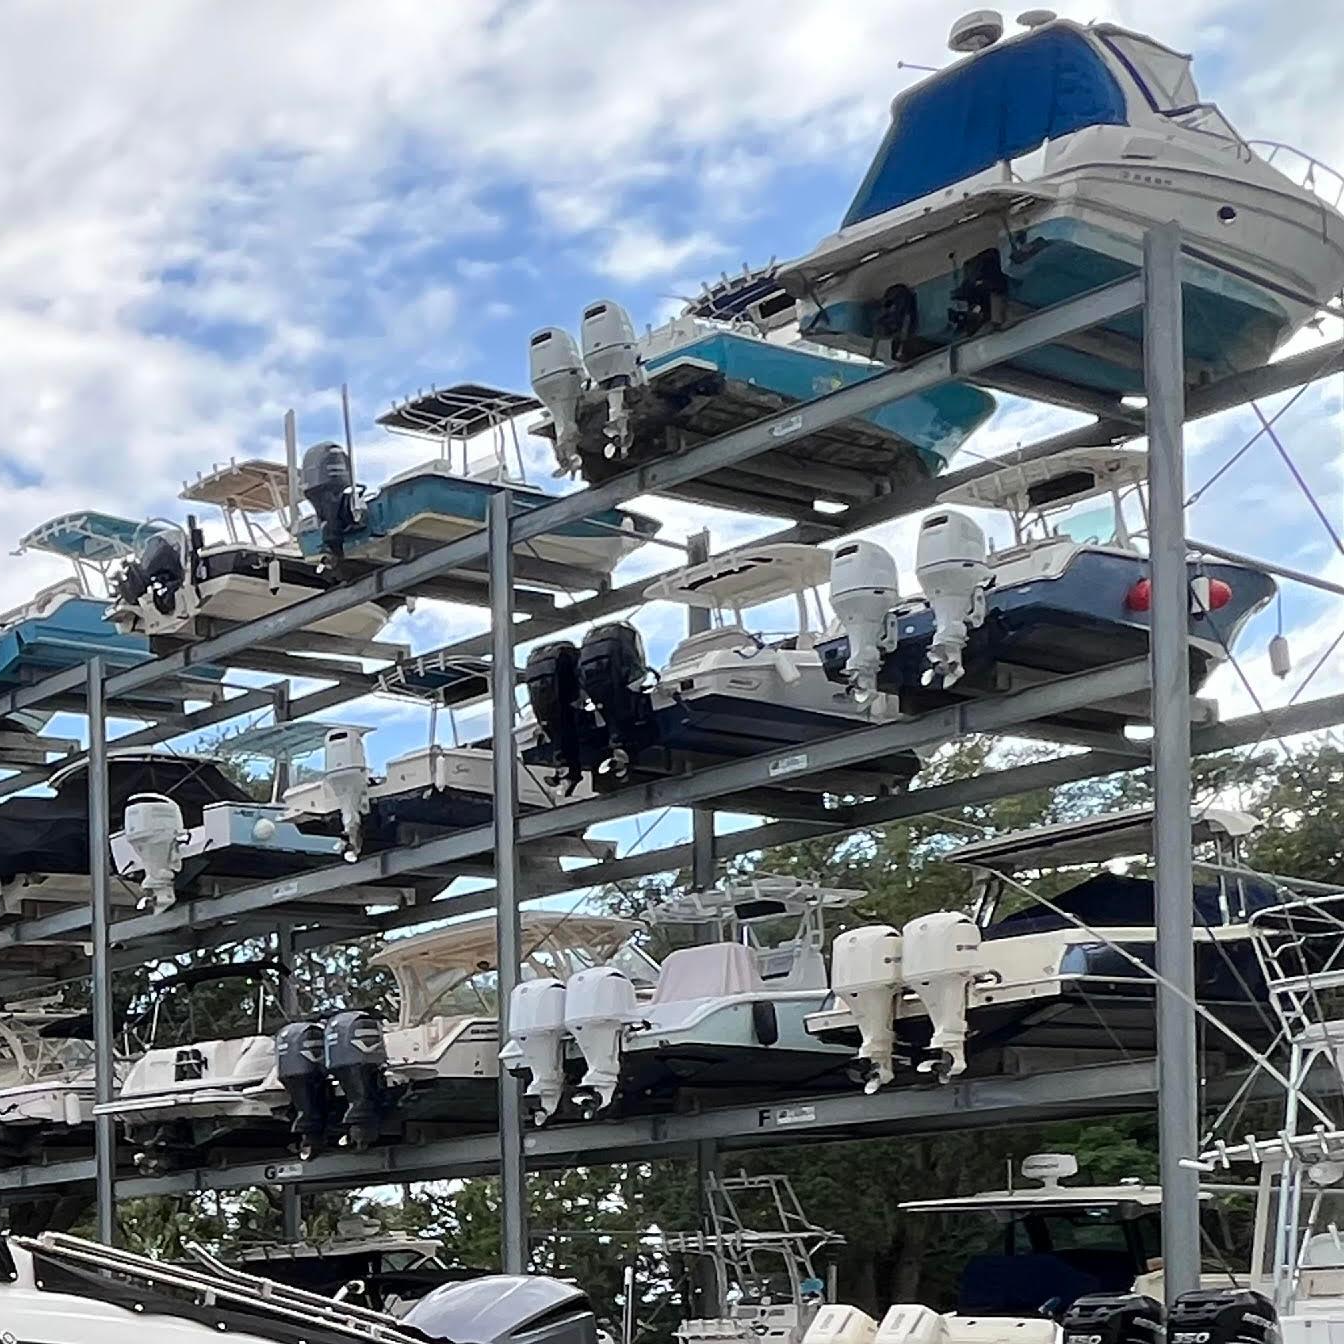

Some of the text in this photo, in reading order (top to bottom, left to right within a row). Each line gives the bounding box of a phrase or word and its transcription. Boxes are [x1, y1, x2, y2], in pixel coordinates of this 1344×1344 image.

[758, 1109, 770, 1127] F
[264, 1165, 276, 1180] G
[1171, 1332, 1210, 1344] 350
